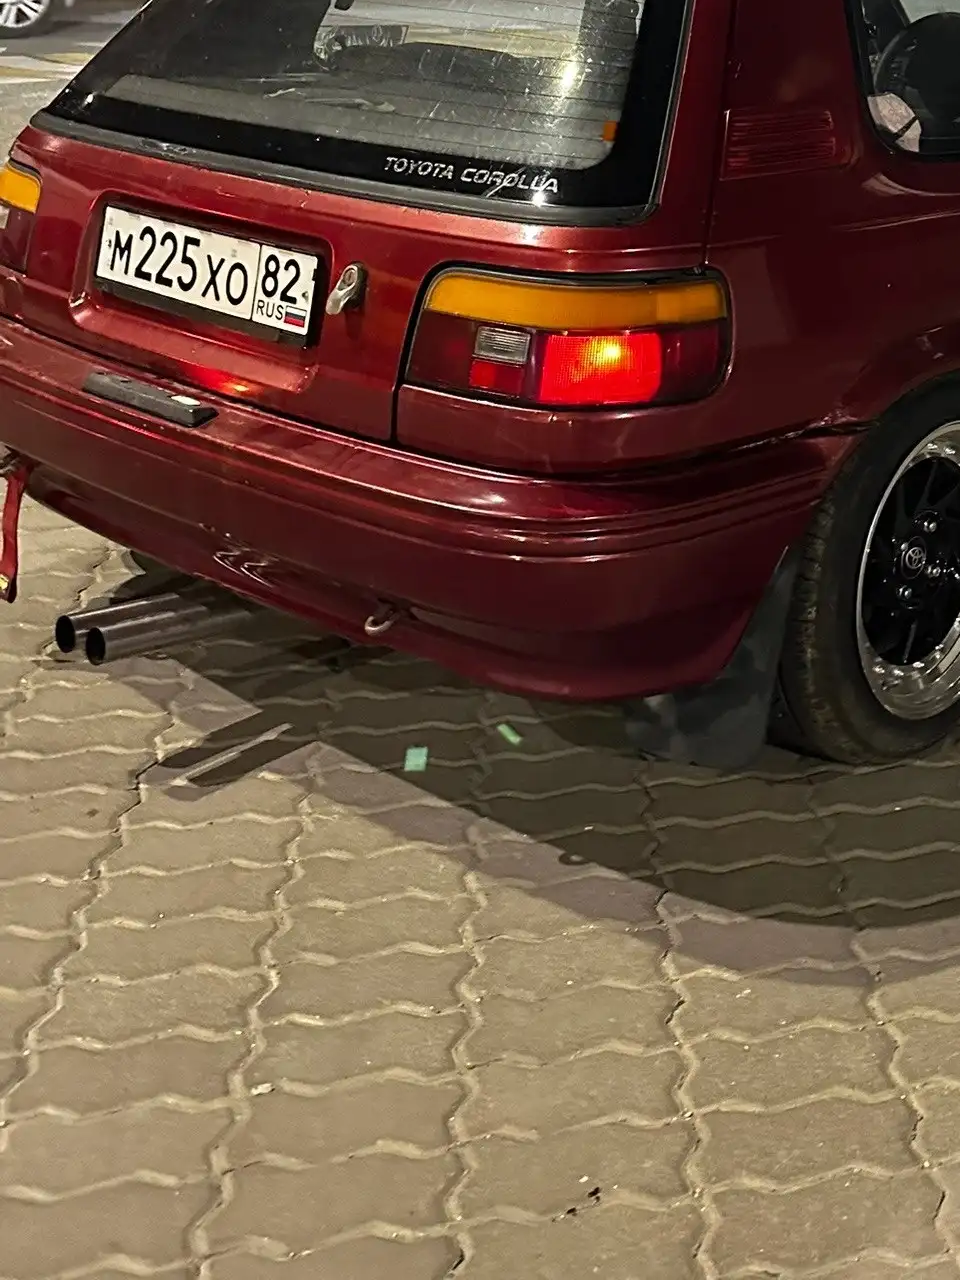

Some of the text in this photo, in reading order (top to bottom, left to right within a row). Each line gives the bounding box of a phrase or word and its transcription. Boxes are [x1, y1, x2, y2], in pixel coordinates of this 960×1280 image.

[384, 156, 558, 193] TOYOTA COROLLA
[261, 253, 301, 305] 82
[256, 301, 284, 321] RUS
